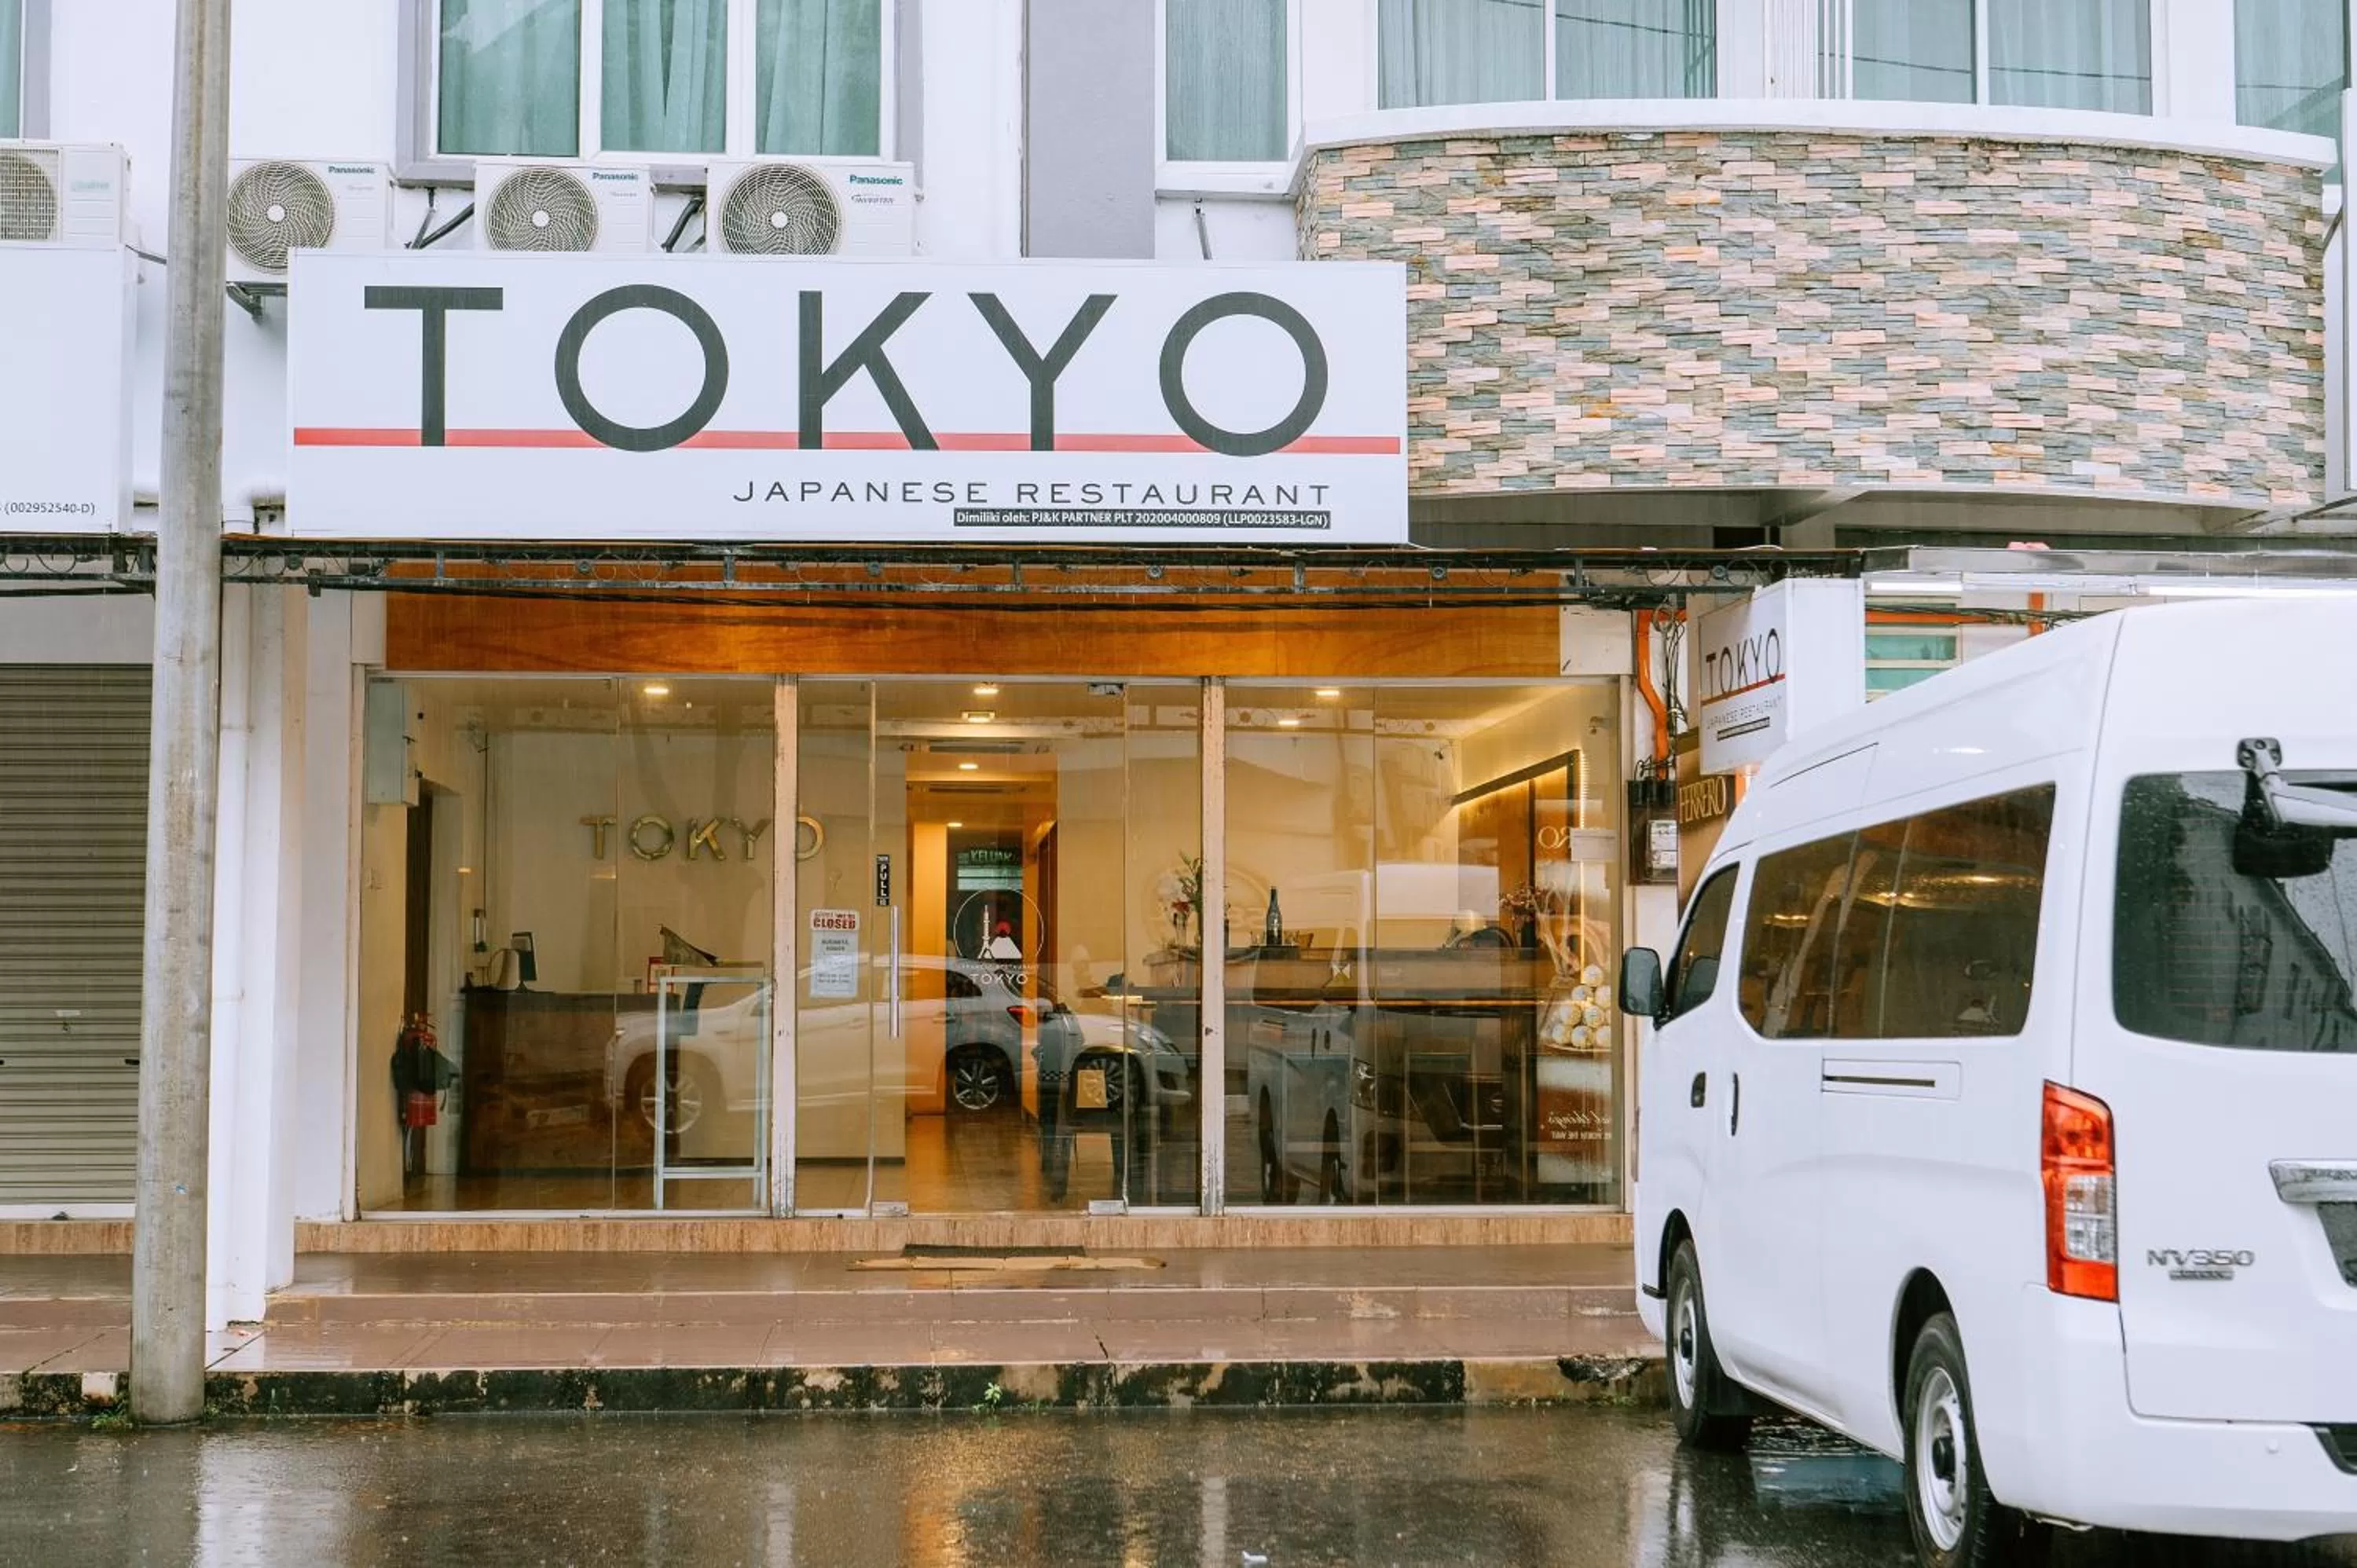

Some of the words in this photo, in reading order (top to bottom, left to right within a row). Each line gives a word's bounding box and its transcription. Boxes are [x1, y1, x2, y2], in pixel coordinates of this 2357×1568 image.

[328, 166, 375, 174] Panasonic
[849, 174, 903, 185] Panasonic
[364, 284, 1329, 456] TOKYO
[732, 481, 988, 504] JAPANESE
[1017, 483, 1330, 505] RESTAURANT
[956, 511, 1000, 523] Dimiliki
[1002, 511, 1029, 523] oleh:
[1032, 512, 1059, 523] PJ&K
[1061, 512, 1112, 523] PARTNER
[1114, 513, 1134, 524] PLT
[1135, 513, 1220, 525] 202004000809
[1222, 513, 1328, 528] (LLP0023583-LGN)
[1706, 628, 1780, 698] TOKYO
[1679, 775, 1727, 824] FERRERO
[580, 816, 824, 861] TOKYO
[813, 918, 855, 929] CLOSED
[970, 973, 1028, 985] TOKYO
[2146, 1249, 2255, 1266] NV350
